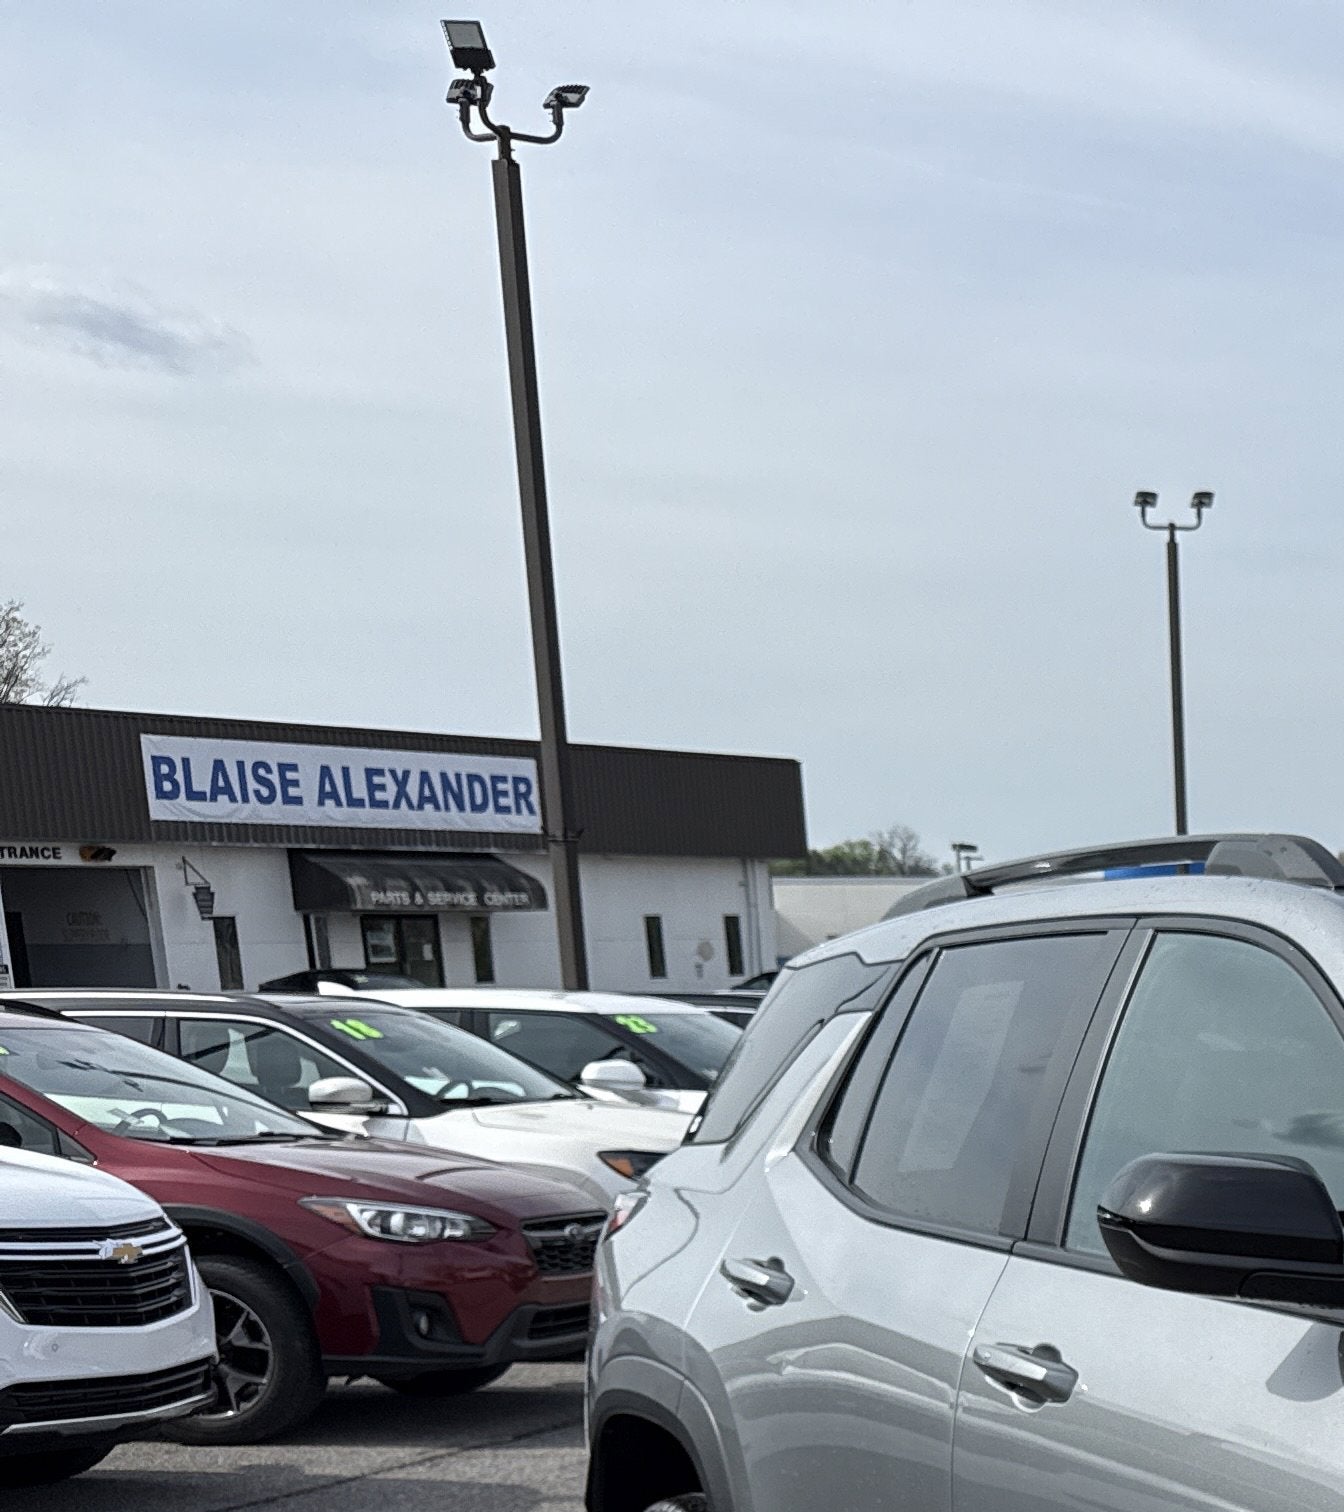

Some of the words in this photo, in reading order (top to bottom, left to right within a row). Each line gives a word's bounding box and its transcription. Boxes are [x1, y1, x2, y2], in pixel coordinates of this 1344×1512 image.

[151, 755, 304, 806] BLAISE
[317, 764, 538, 817] ALEXANDER
[370, 890, 410, 905] PARTS
[427, 891, 478, 906] SERVICE
[483, 891, 530, 906] CENTER
